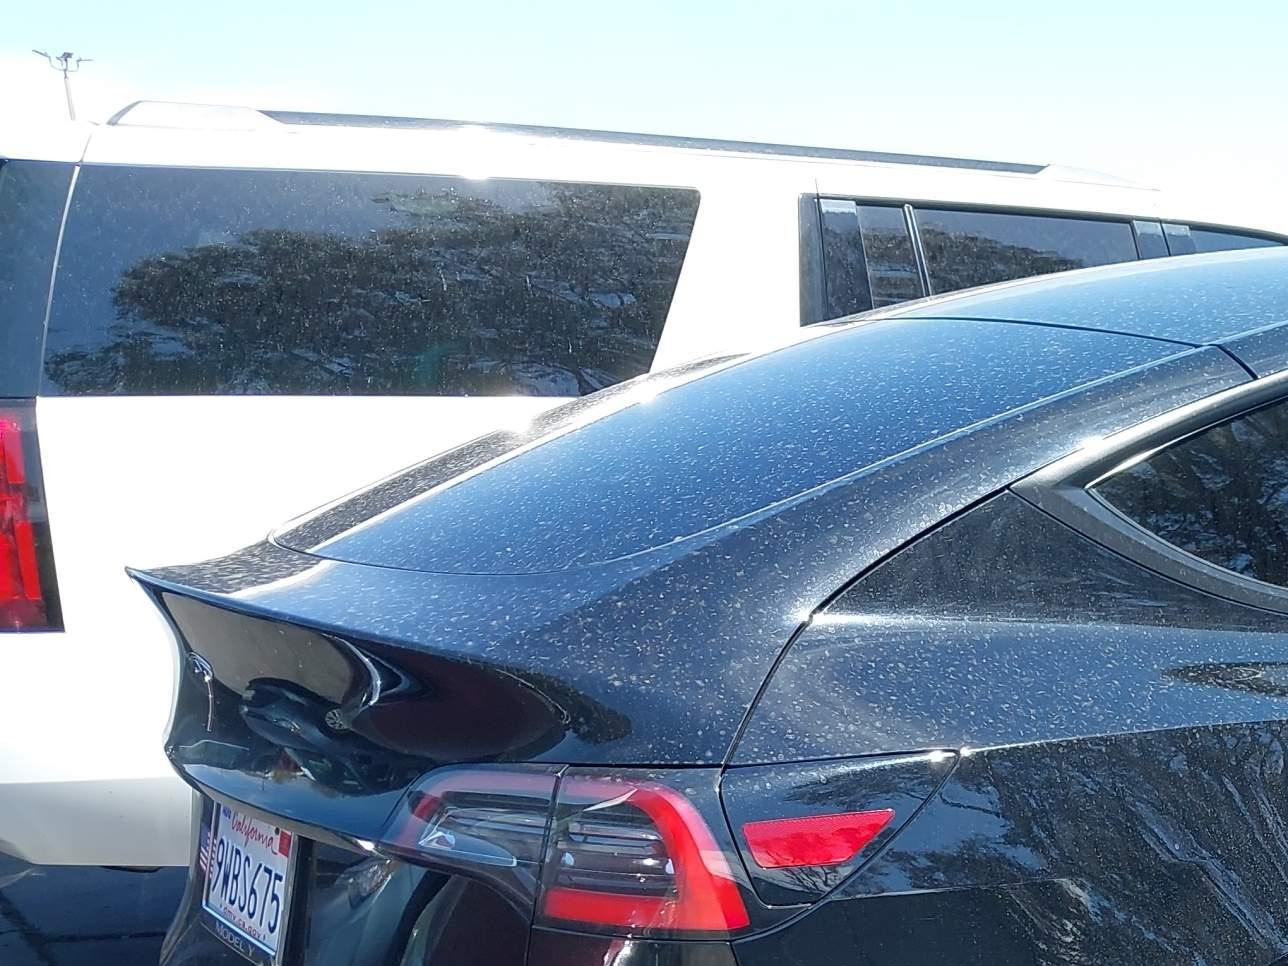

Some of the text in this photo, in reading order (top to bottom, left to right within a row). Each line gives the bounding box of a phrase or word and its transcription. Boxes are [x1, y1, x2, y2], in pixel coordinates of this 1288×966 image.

[230, 812, 279, 855] California
[212, 837, 284, 934] 9WBS675
[215, 920, 256, 957] MODEL Y
